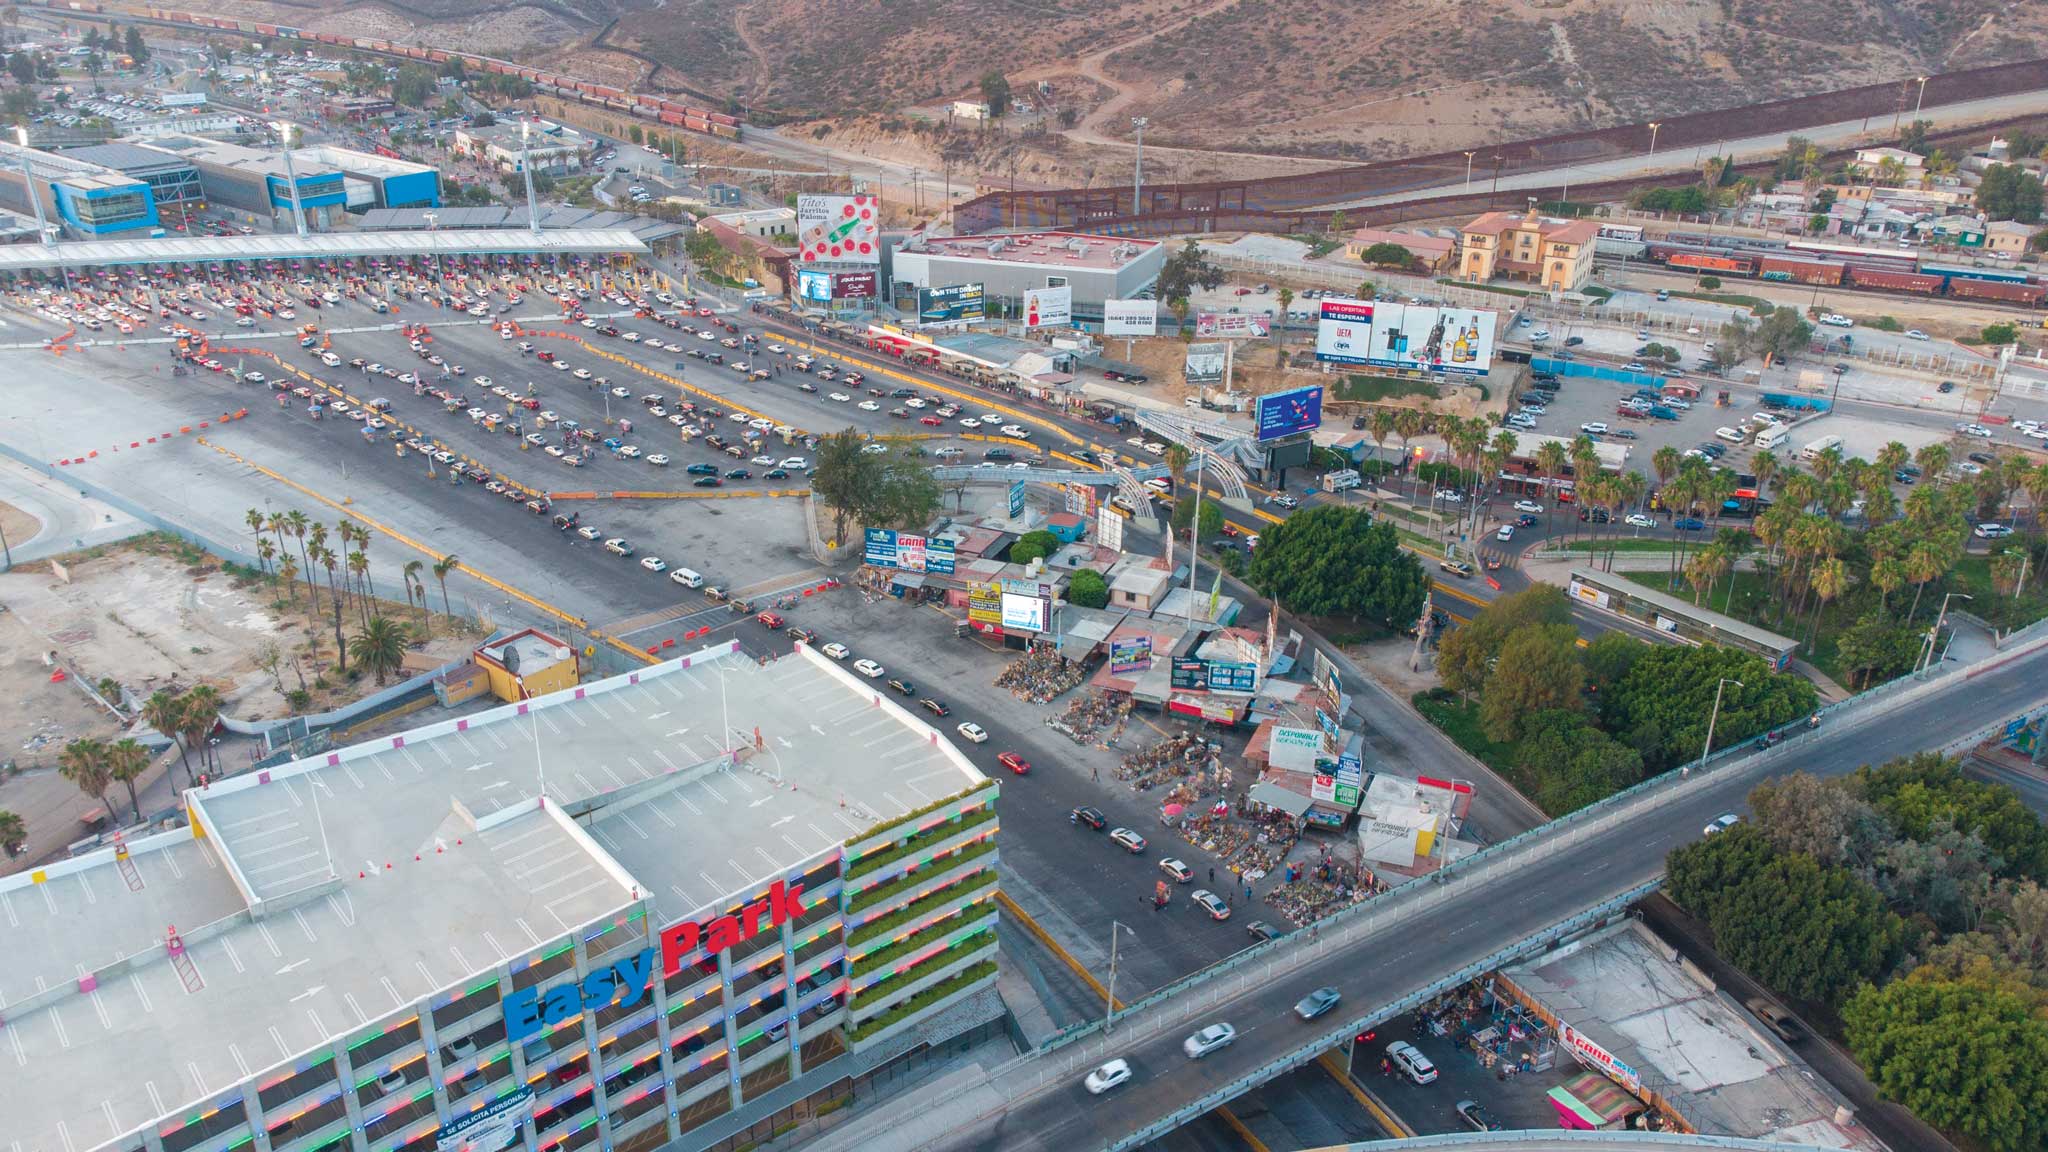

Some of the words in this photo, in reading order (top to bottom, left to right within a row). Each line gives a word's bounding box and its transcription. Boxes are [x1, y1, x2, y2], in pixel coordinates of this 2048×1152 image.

[800, 198, 826, 207] Tito's
[1337, 313, 1365, 321] ESPERAN
[1279, 729, 1318, 740] DISPONIBLE
[502, 947, 656, 1042] Easy
[660, 879, 805, 979] Park
[1576, 1039, 1611, 1064] GANA
[446, 1127, 457, 1135] SE
[457, 1110, 490, 1130] SOLICITA
[490, 1092, 527, 1114] PERSONAL
